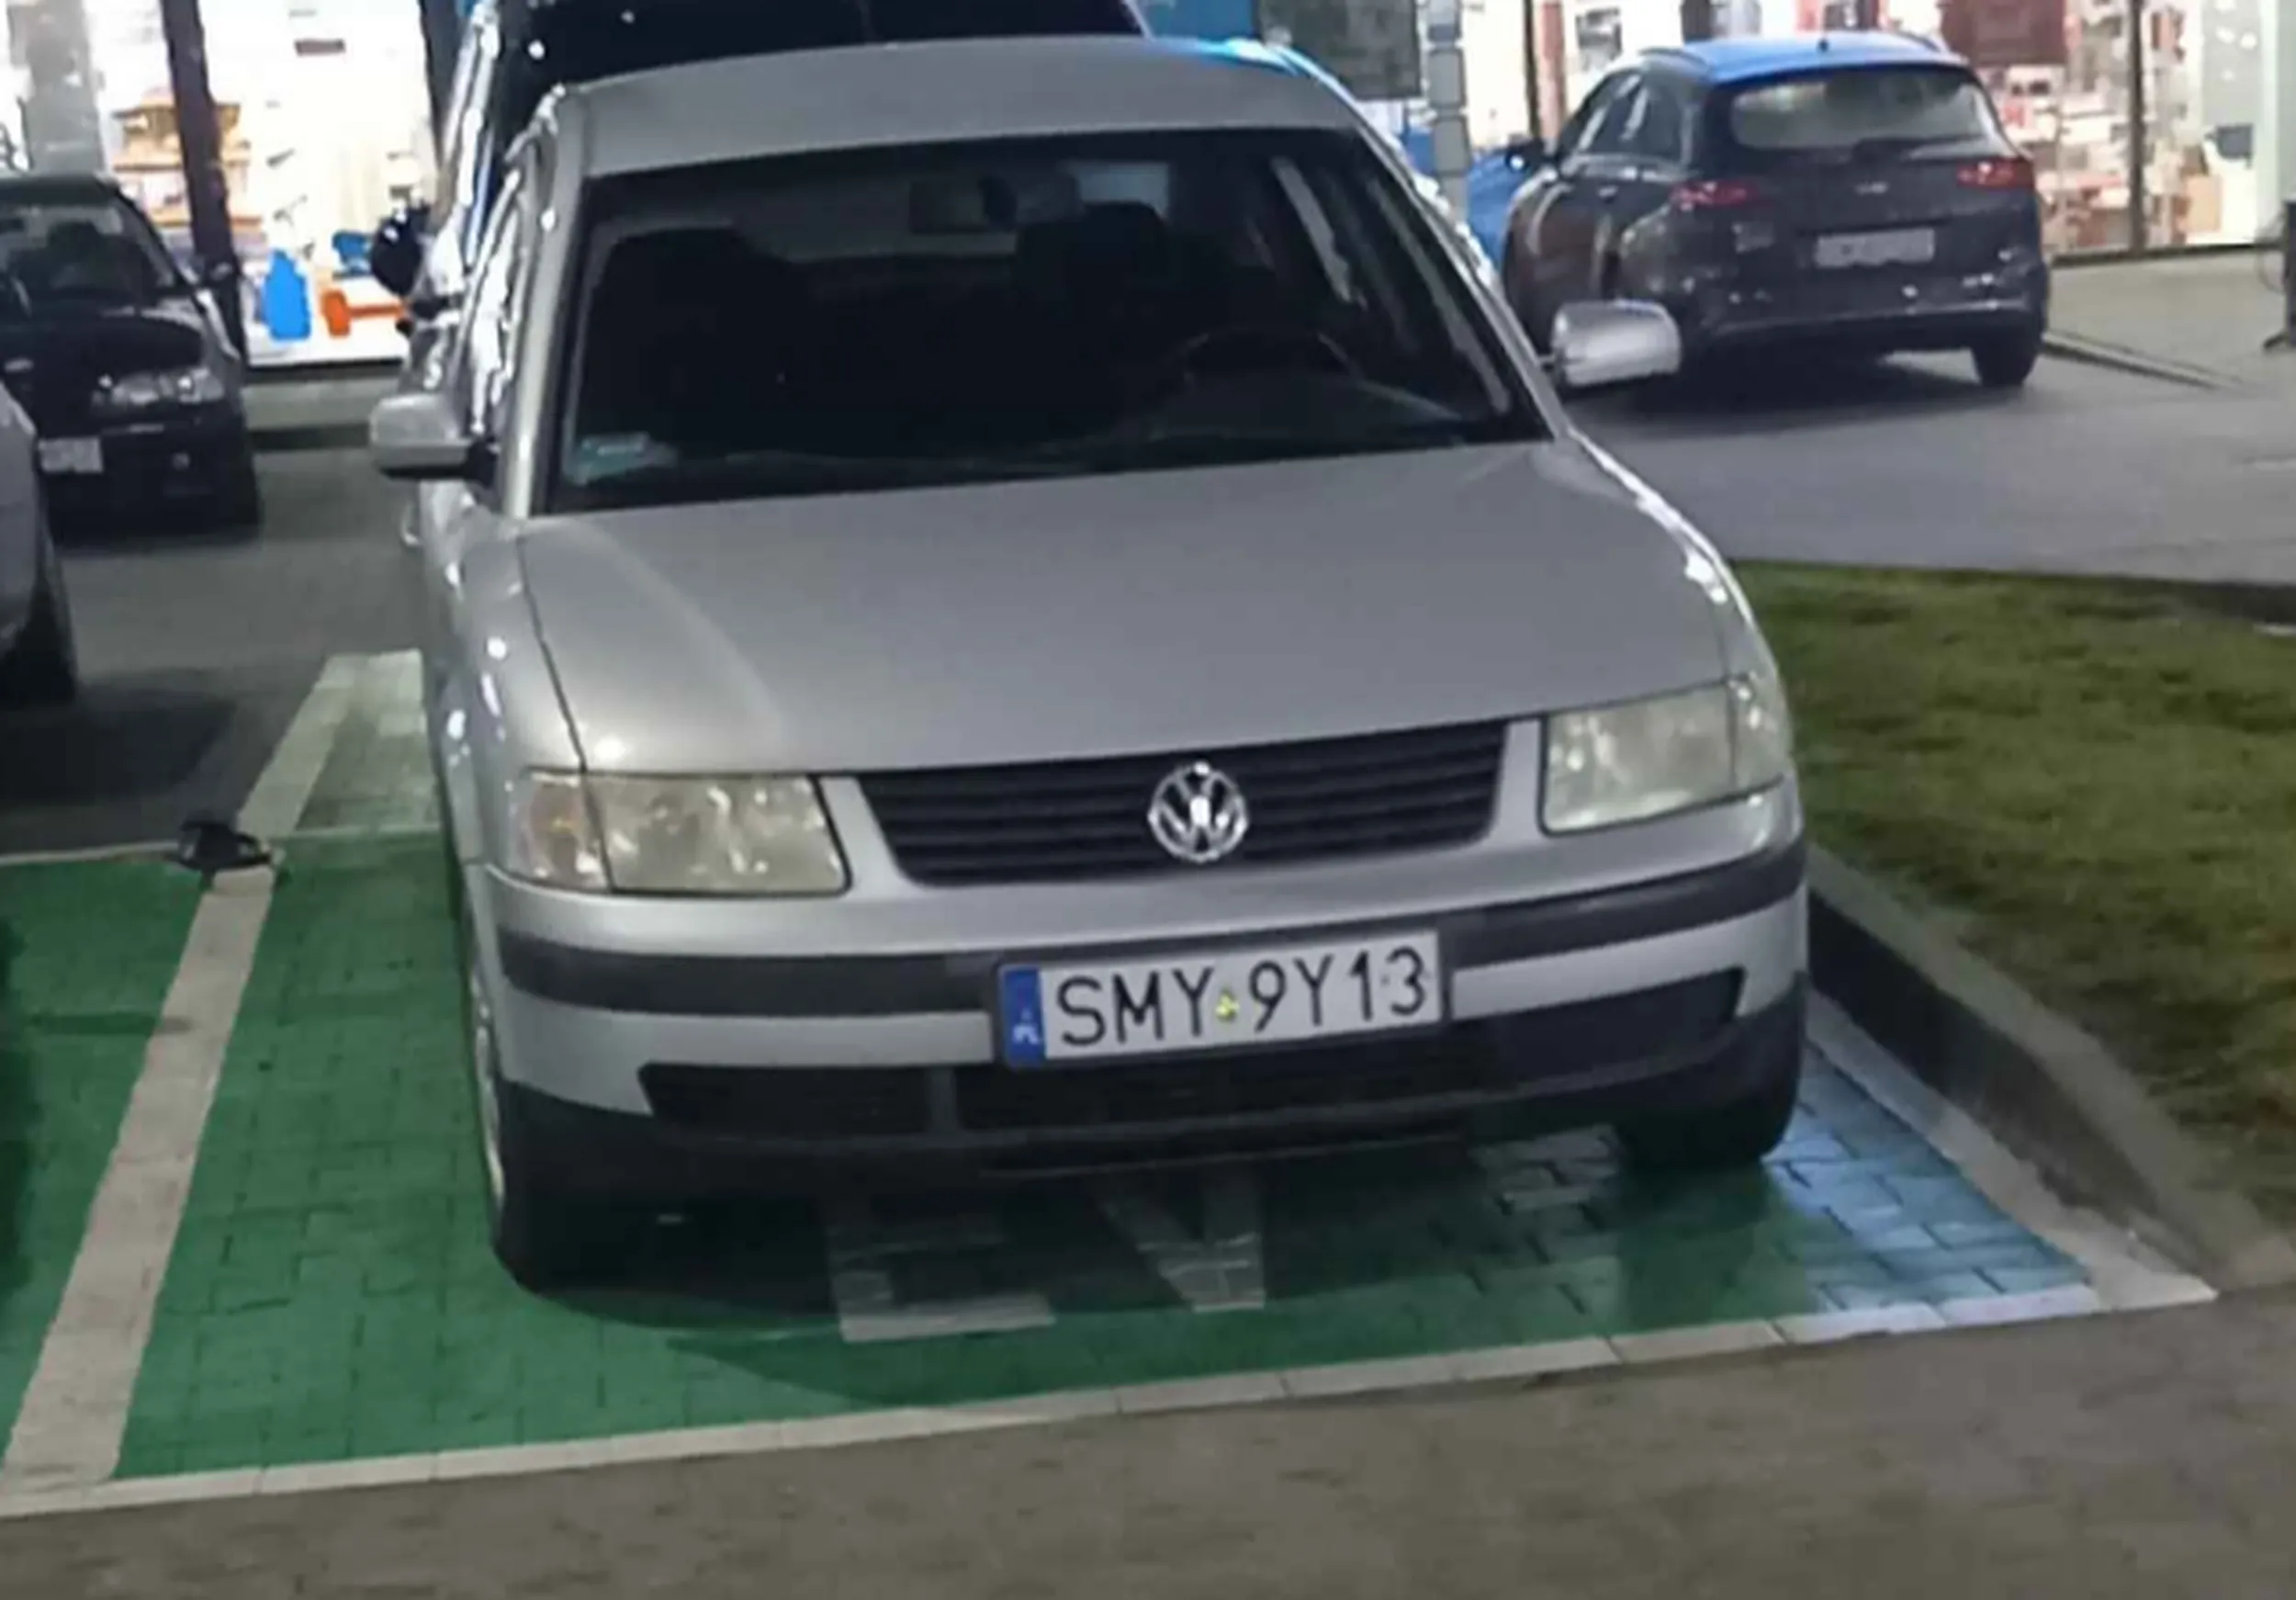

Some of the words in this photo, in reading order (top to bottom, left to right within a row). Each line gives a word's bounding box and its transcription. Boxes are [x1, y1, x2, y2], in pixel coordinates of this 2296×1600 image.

[1151, 764, 1245, 860] VW
[1055, 966, 1216, 1047] SMY
[1248, 945, 1428, 1033] 9Y13
